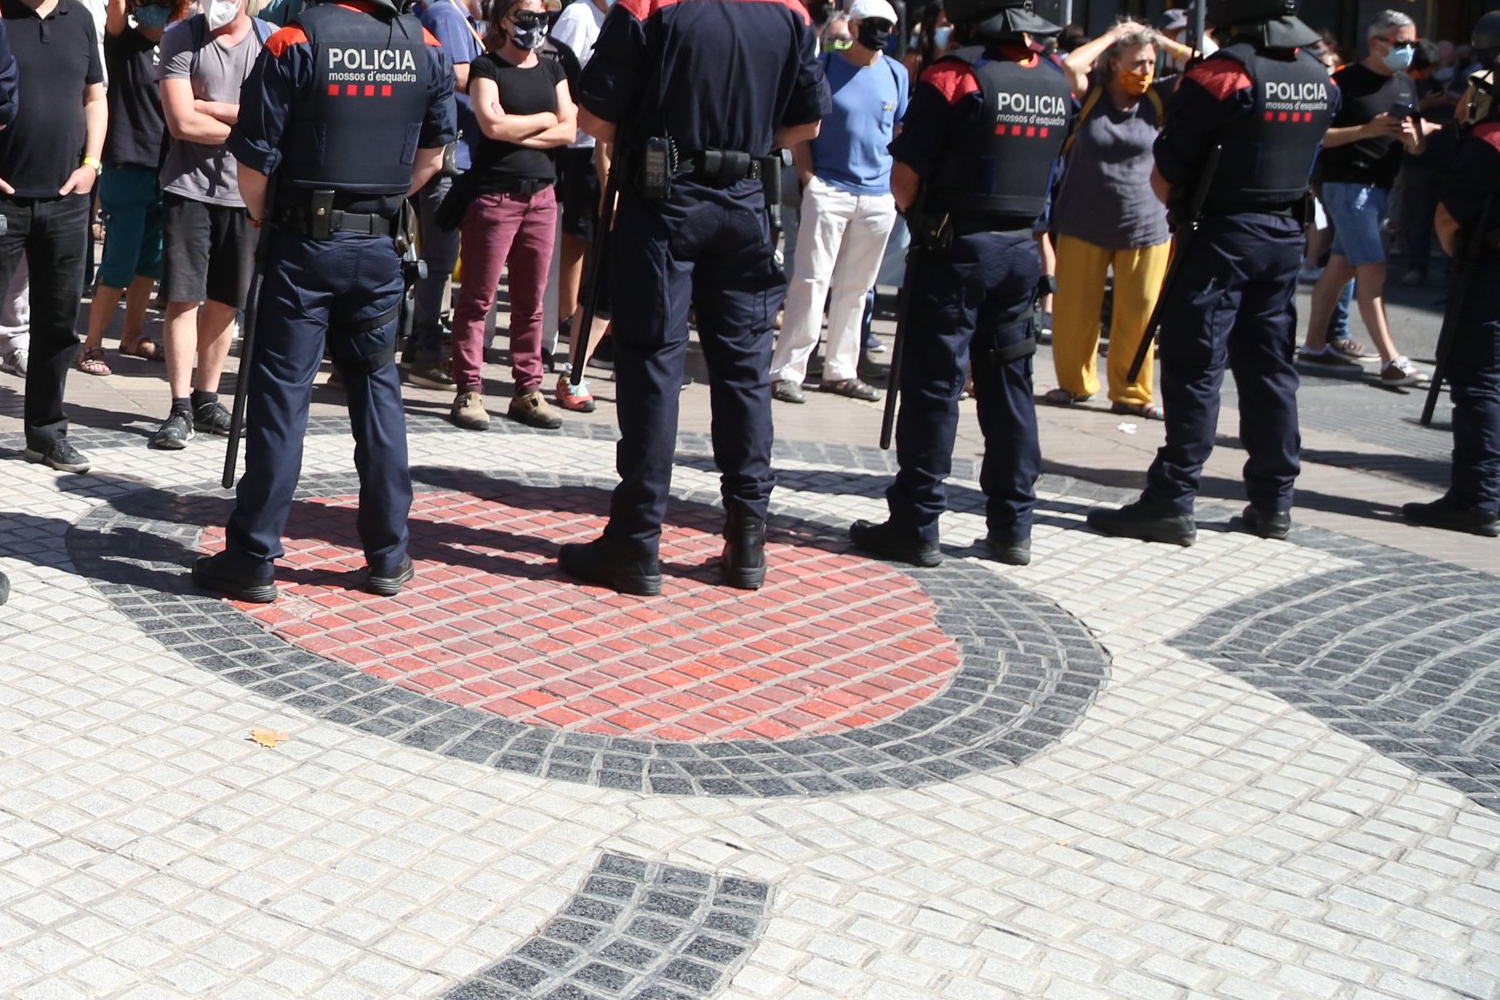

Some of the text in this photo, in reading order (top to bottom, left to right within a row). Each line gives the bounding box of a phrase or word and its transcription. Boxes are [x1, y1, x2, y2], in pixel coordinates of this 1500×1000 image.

[328, 48, 416, 71] POLICIA
[328, 72, 366, 81] mossos
[1265, 81, 1328, 100] POLICIA
[998, 92, 1066, 116] POLICIA
